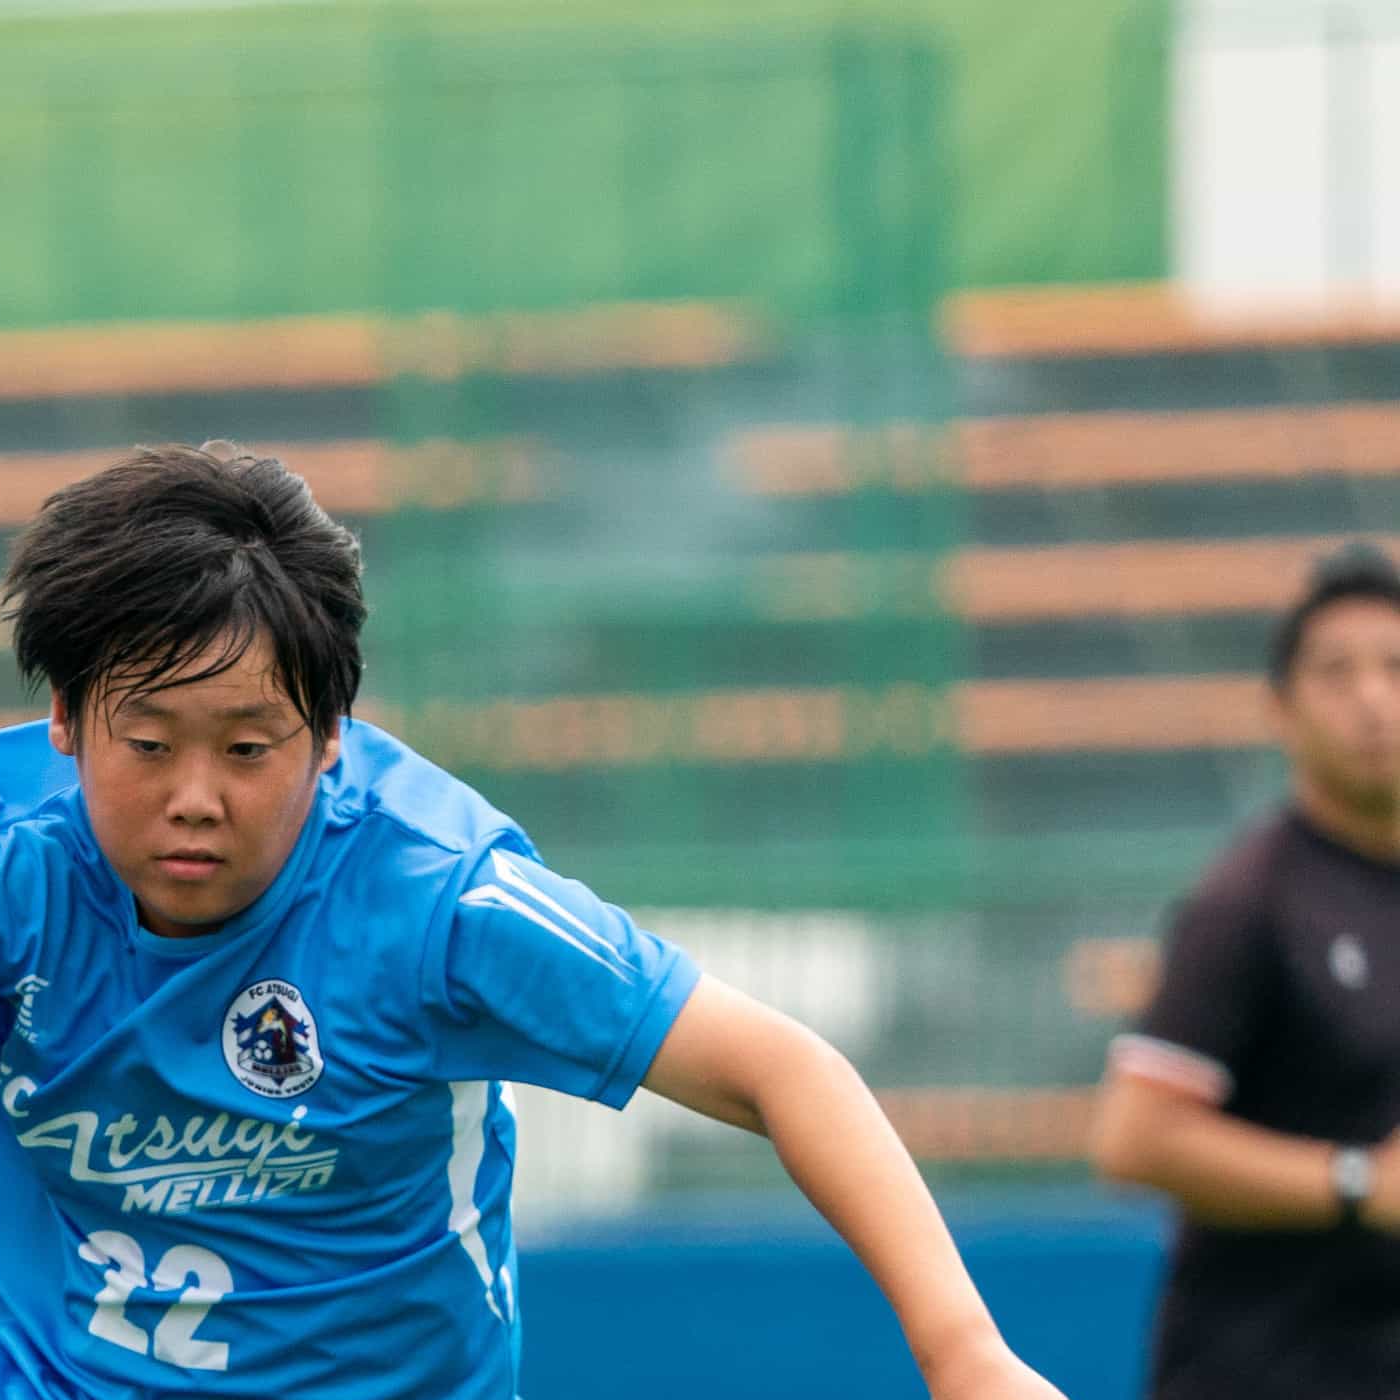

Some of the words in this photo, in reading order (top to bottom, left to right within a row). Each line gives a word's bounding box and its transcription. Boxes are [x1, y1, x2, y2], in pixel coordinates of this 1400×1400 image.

[248, 986, 265, 1000] FC
[266, 983, 300, 1003] ATSUGI
[15, 1104, 339, 1185] Atsugi
[119, 1163, 337, 1216] MELLIZO
[78, 1230, 234, 1371] 22
